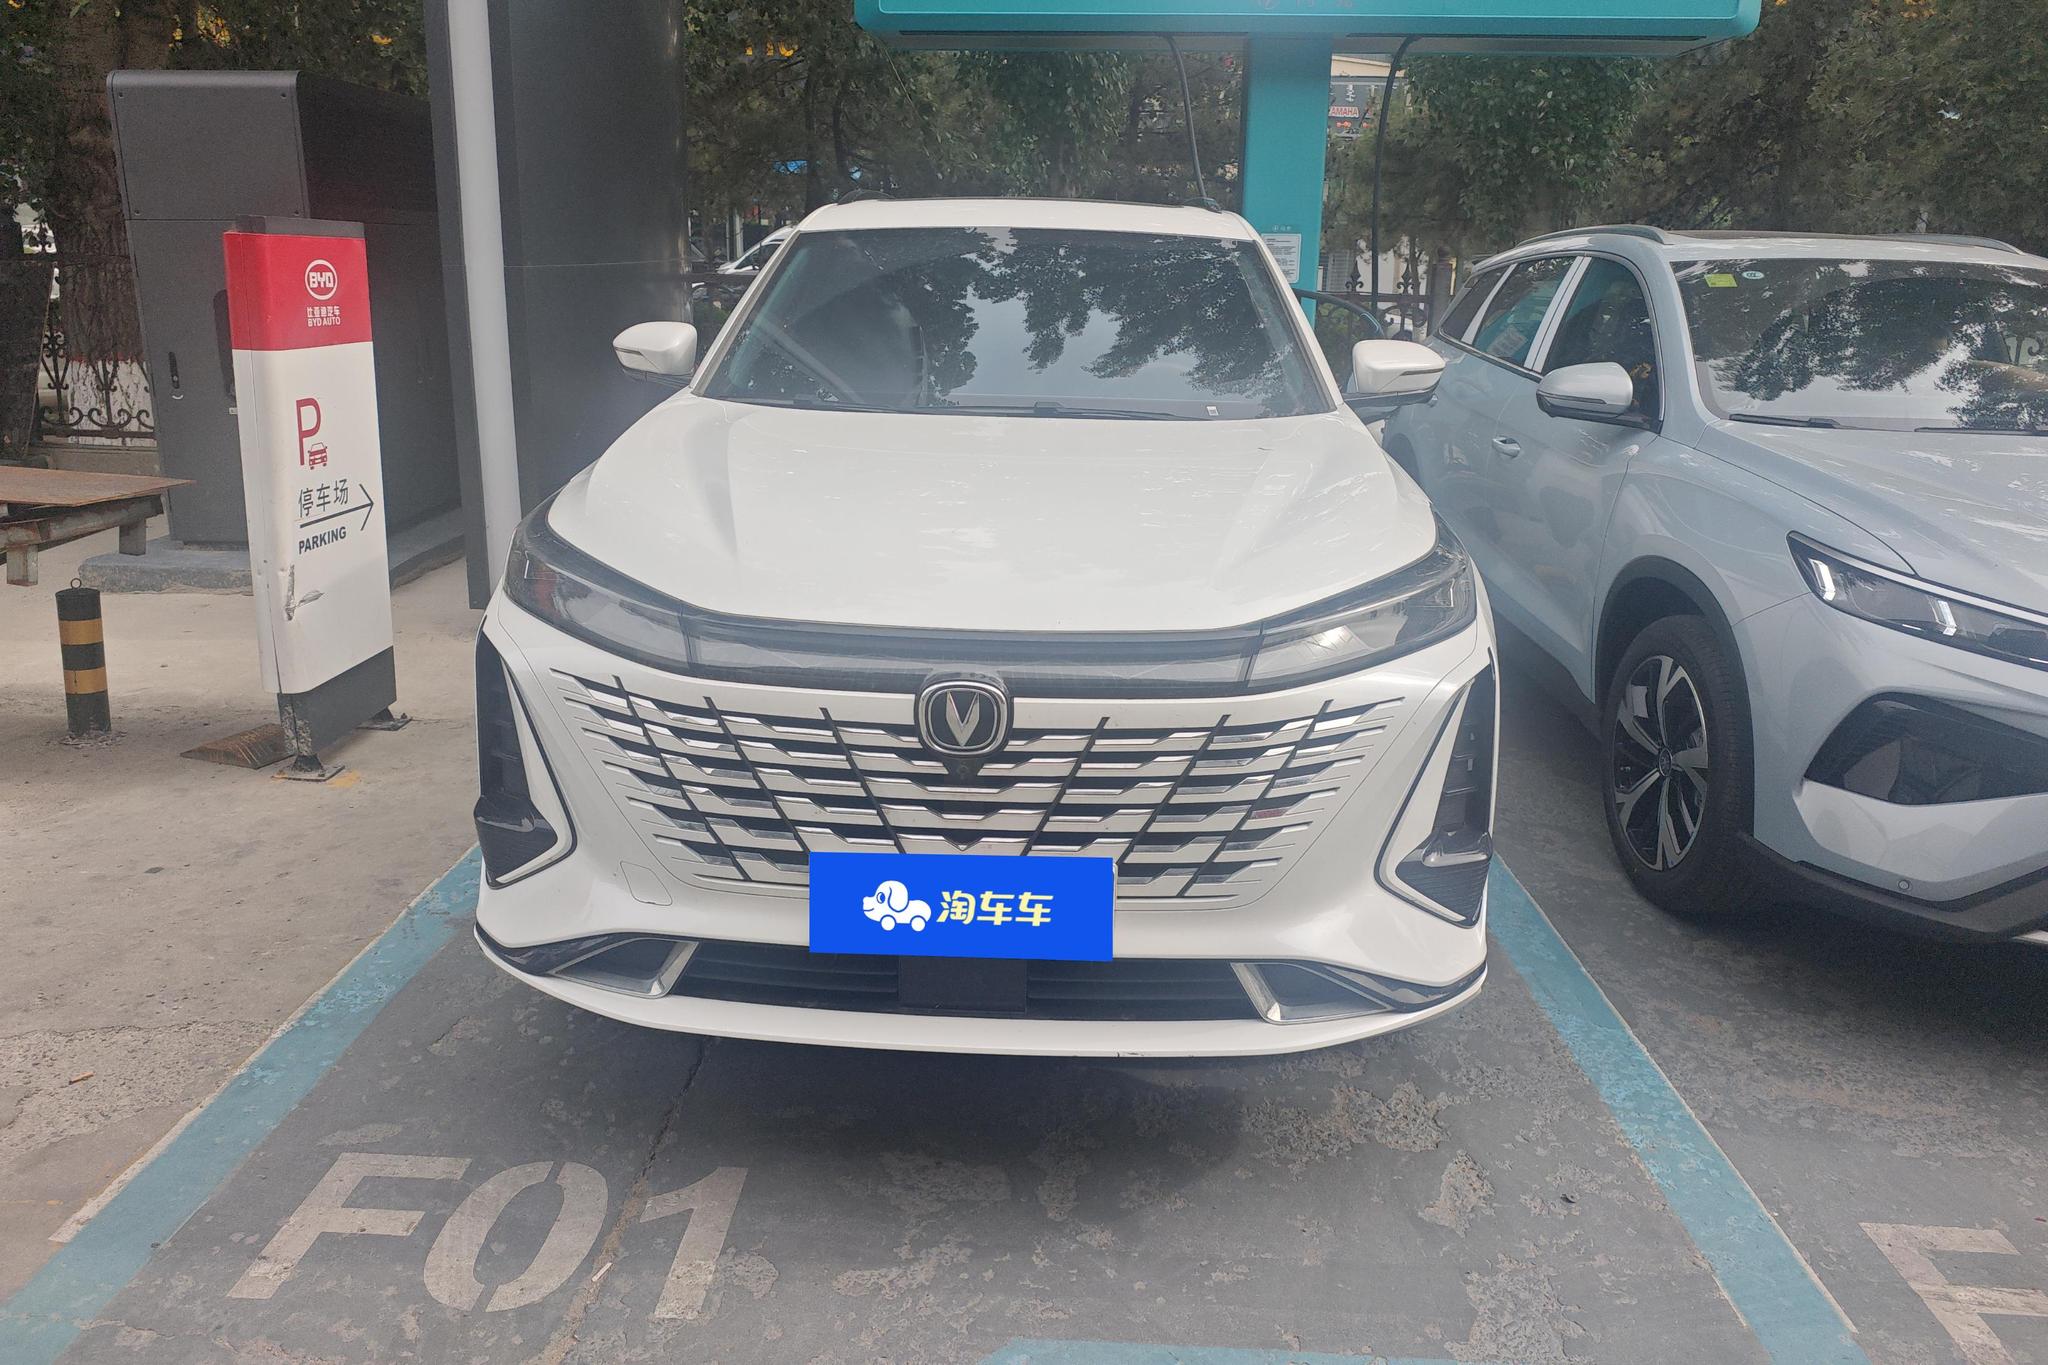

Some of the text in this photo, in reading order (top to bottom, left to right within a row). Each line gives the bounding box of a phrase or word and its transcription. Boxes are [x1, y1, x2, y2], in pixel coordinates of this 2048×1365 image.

[1331, 107, 1358, 116] AMAHA
[309, 272, 334, 288] BYD
[308, 317, 341, 327] BYD AUTO
[295, 397, 322, 466] P
[298, 478, 349, 518] 停车场
[298, 526, 347, 555] PARKING
[226, 1152, 748, 1320] F01
